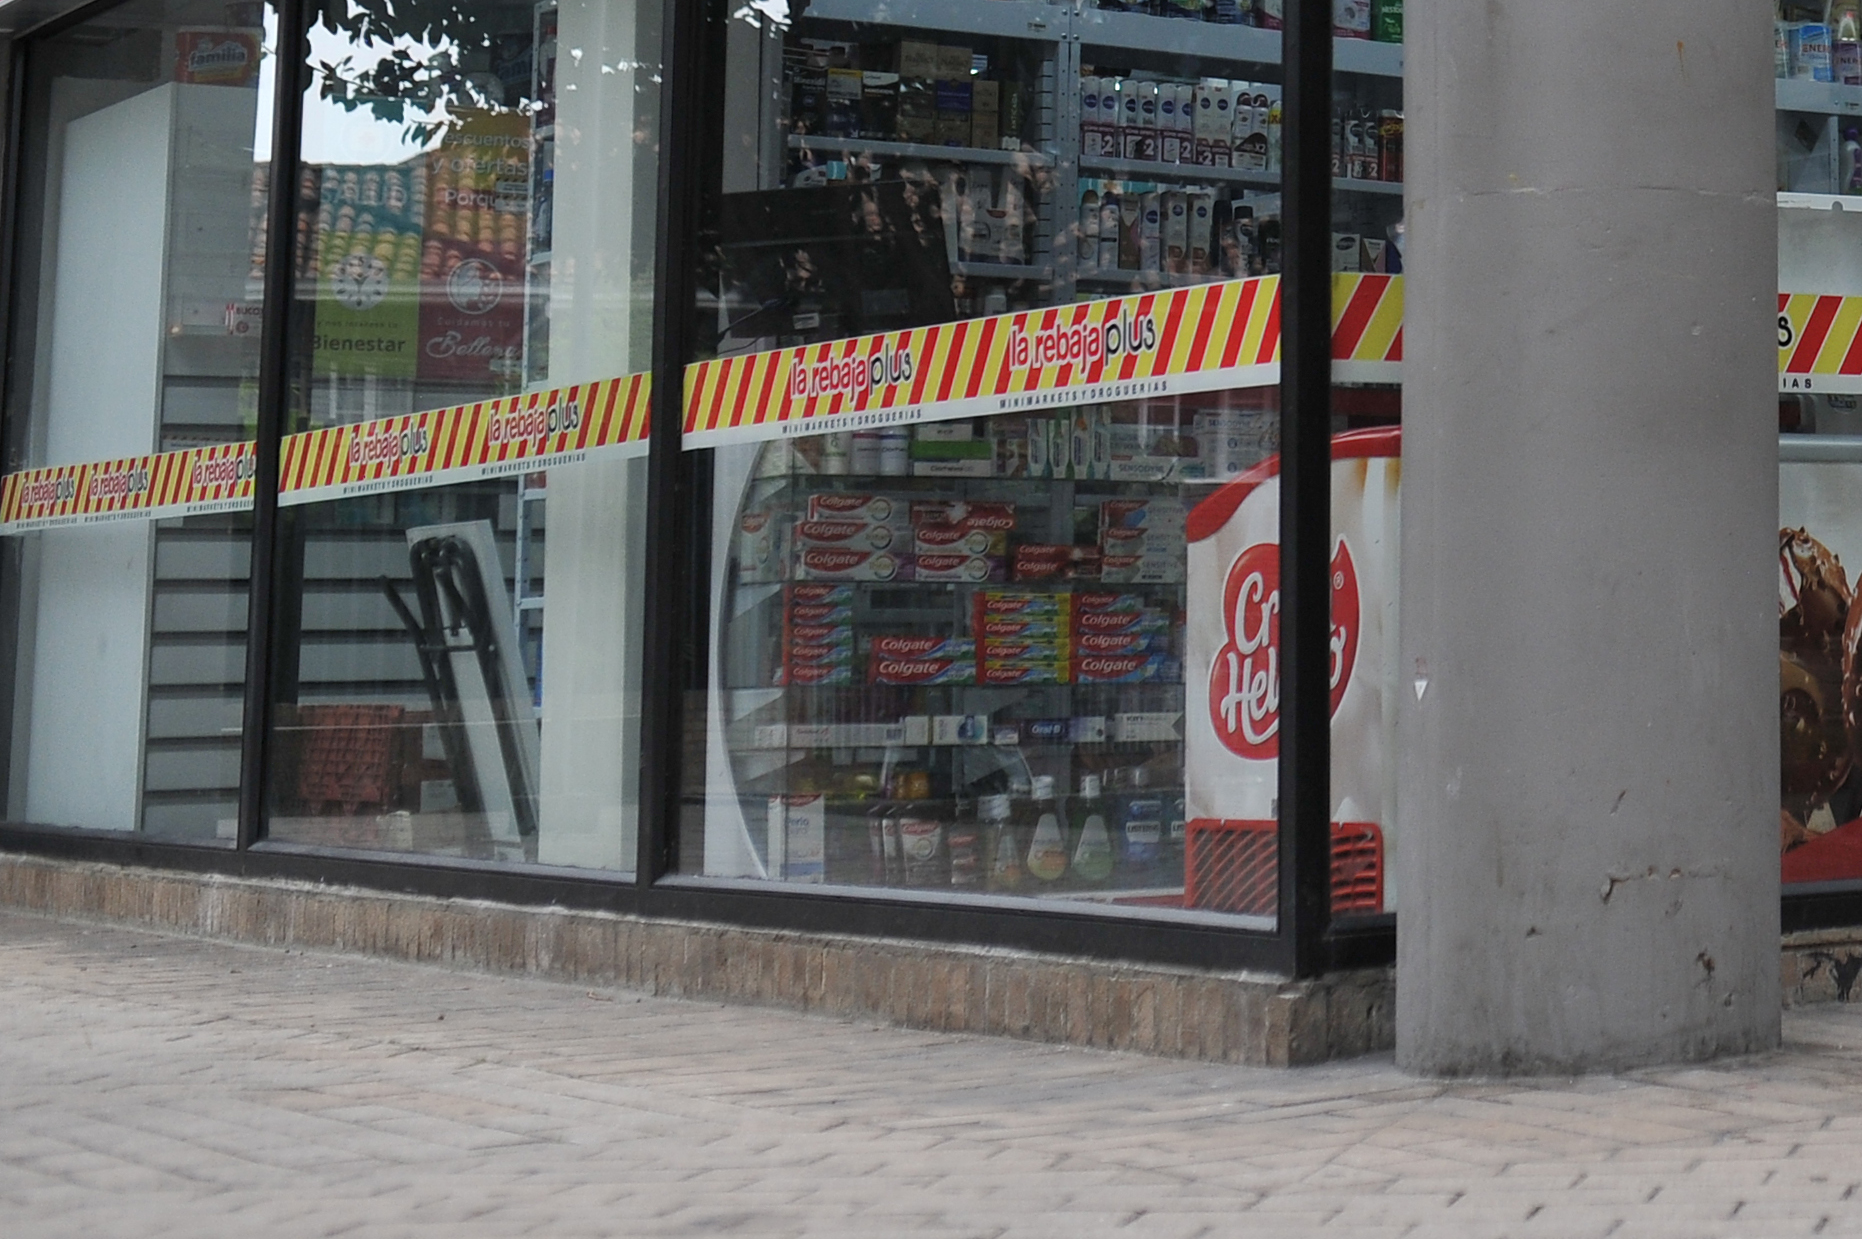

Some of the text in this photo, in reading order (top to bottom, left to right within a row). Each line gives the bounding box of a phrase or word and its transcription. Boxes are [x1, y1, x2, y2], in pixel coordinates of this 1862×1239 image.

[190, 48, 246, 66] familia
[444, 132, 530, 149] escuentos
[445, 190, 497, 209] Porqu
[312, 336, 405, 352] Bienestar
[1011, 306, 1155, 374] la rebaja plus
[792, 336, 914, 404] la rebaja plus
[1000, 391, 1078, 410] MINIMARKETS
[1091, 380, 1168, 400] DROGUERIAS
[489, 396, 580, 449] la rebaja plus
[350, 423, 428, 469] la rebaja plus
[236, 451, 255, 487] plu
[1118, 463, 1164, 473] SENSODYNE
[804, 523, 857, 537] Colgate
[919, 530, 961, 541] Colgate
[806, 554, 859, 566] Colgate
[919, 556, 960, 566] Colgate
[1017, 562, 1058, 572] Colgate
[1082, 614, 1131, 627] Colgate
[881, 639, 934, 653] Colgate
[1082, 635, 1132, 647] Colgate
[879, 661, 939, 677] Colgate
[1082, 657, 1137, 671] Colgate
